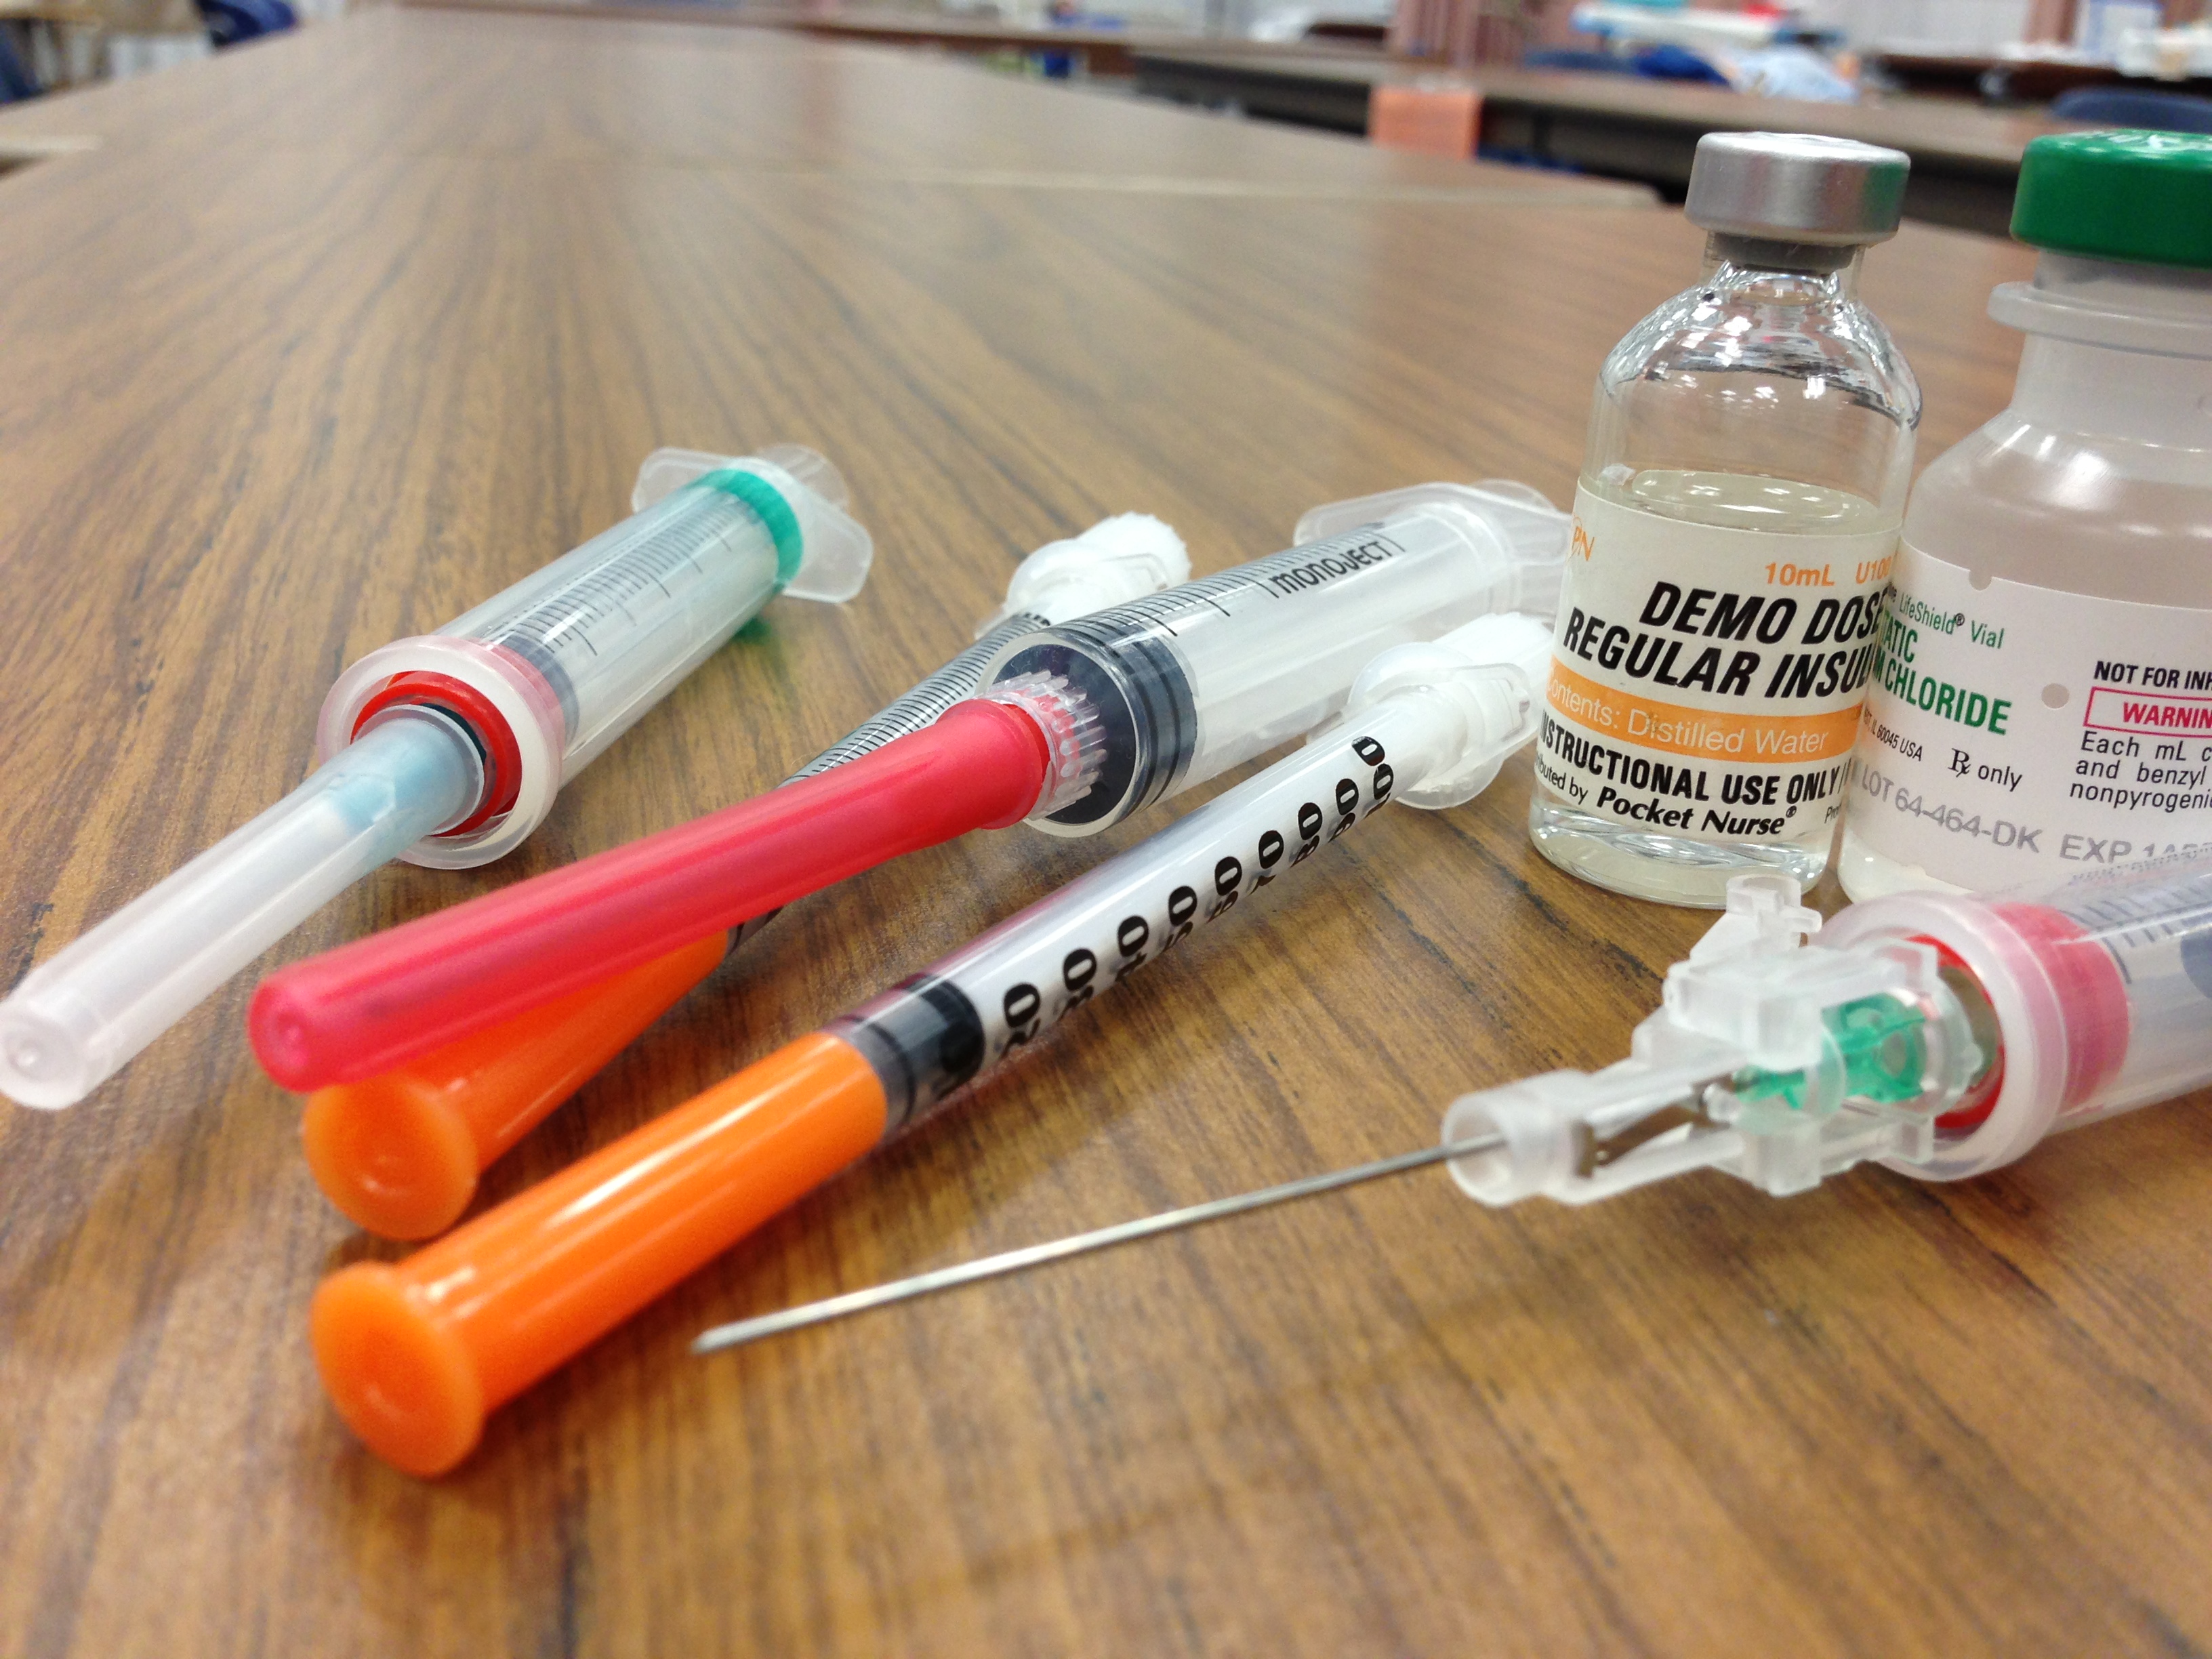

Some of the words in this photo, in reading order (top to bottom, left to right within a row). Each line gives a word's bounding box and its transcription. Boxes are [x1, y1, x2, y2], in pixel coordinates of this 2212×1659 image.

[1765, 562, 1835, 587] 10mL
[1639, 581, 1797, 645] DEMO
[1563, 606, 1760, 696] REGULAR
[1971, 619, 2005, 655] Vial
[2093, 660, 2139, 684] NOT
[2142, 667, 2180, 689] FOR
[1885, 658, 2012, 735] CHLORIDE
[1628, 708, 1743, 754] Distilled
[1755, 729, 1829, 756] Water
[1900, 738, 1923, 762] USA
[2081, 730, 2141, 758] Each
[2154, 740, 2187, 762] mL
[1721, 773, 1781, 805] USE
[1786, 765, 1841, 805] ONLY
[1978, 765, 2023, 792] only
[2075, 759, 2121, 779] and
[2136, 762, 2207, 790] benzyl
[1569, 776, 1589, 806] by
[1596, 785, 1694, 830] Pocket
[1861, 764, 1895, 802] LOT
[1895, 787, 2043, 854] 64-464-DK
[2059, 834, 2133, 864] EXP
